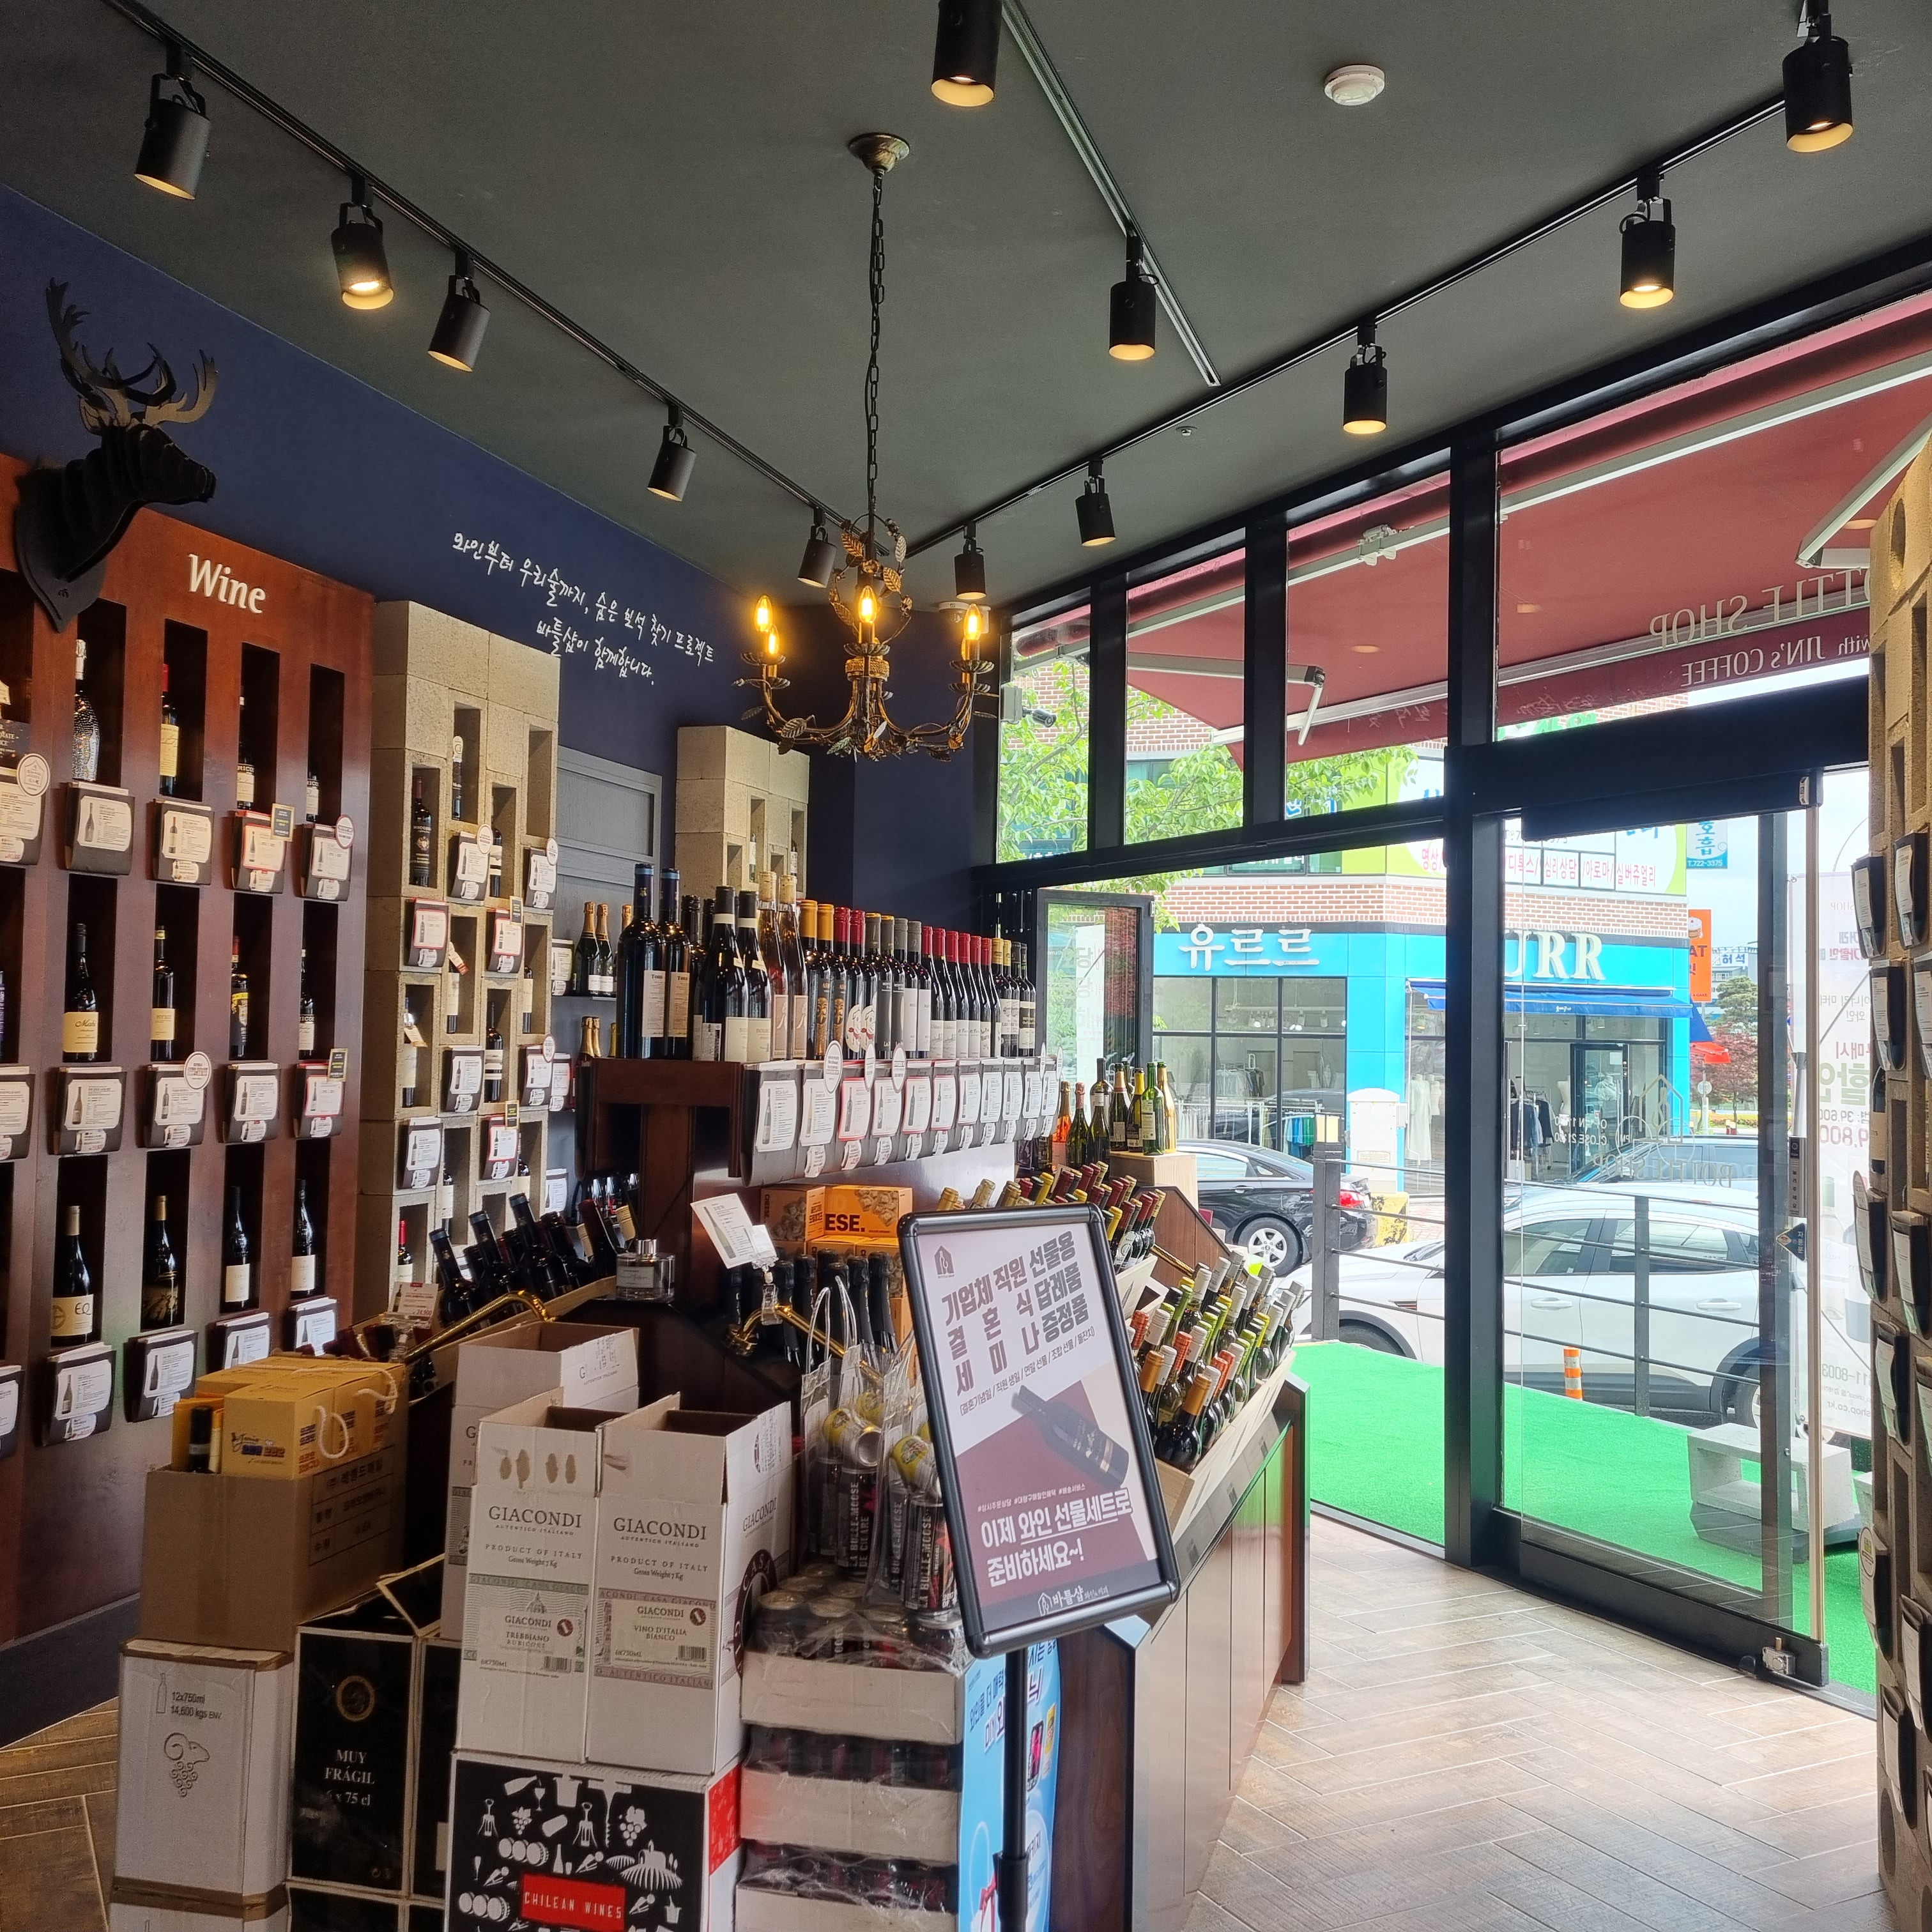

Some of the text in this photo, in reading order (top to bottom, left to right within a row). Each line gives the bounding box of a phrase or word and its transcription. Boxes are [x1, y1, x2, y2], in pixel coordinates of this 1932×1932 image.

[188, 553, 266, 614] Wine
[452, 532, 513, 575] 와인부터
[519, 558, 588, 614] 우리술까지,
[595, 592, 618, 622] 숨은
[650, 613, 671, 646] 찾기
[674, 631, 714, 666] 프로젝트
[536, 617, 654, 686] 바틀샵이 함께합니다.
[1544, 859, 1577, 880] 심리상담
[1616, 862, 1657, 887] 실버쥬얼리
[1178, 923, 1319, 971] 유르르
[942, 1230, 1076, 1326] 기업체 직원 선물용
[947, 1261, 1082, 1361] 결 혼 식 답례품
[955, 1292, 1089, 1397] 세 미 나 증정품
[996, 1378, 1008, 1393] 직원
[1008, 1371, 1020, 1386] 생일
[1024, 1362, 1036, 1377] 연말
[1036, 1355, 1048, 1370] 선물
[1063, 1339, 1074, 1353] 선물
[489, 1506, 582, 1528] GIACONDI
[742, 1496, 778, 1532] GIACONDI
[981, 1488, 1133, 1547] 이제 와인 선물세트로
[613, 1517, 707, 1540] GIACONDI
[485, 1544, 583, 1560] PRODUCT OF ITALY
[611, 1555, 657, 1566] PRODUCT
[679, 1563, 709, 1572] ITALY
[987, 1538, 1084, 1588] 준비하세요~!
[650, 1569, 671, 1579] Weight
[1053, 1585, 1084, 1608] 바틀샵
[505, 1616, 551, 1628] GIACONDI
[637, 1606, 684, 1618] GIACONDI
[634, 1625, 654, 1634] VINO
[172, 1691, 205, 1705] 12x750ml
[336, 1749, 367, 1763] MUY
[325, 1765, 375, 1784] FRÁGIL
[345, 1791, 358, 1804] 75
[361, 1794, 371, 1807] cl
[524, 1892, 622, 1919] CHILEAN WINES
